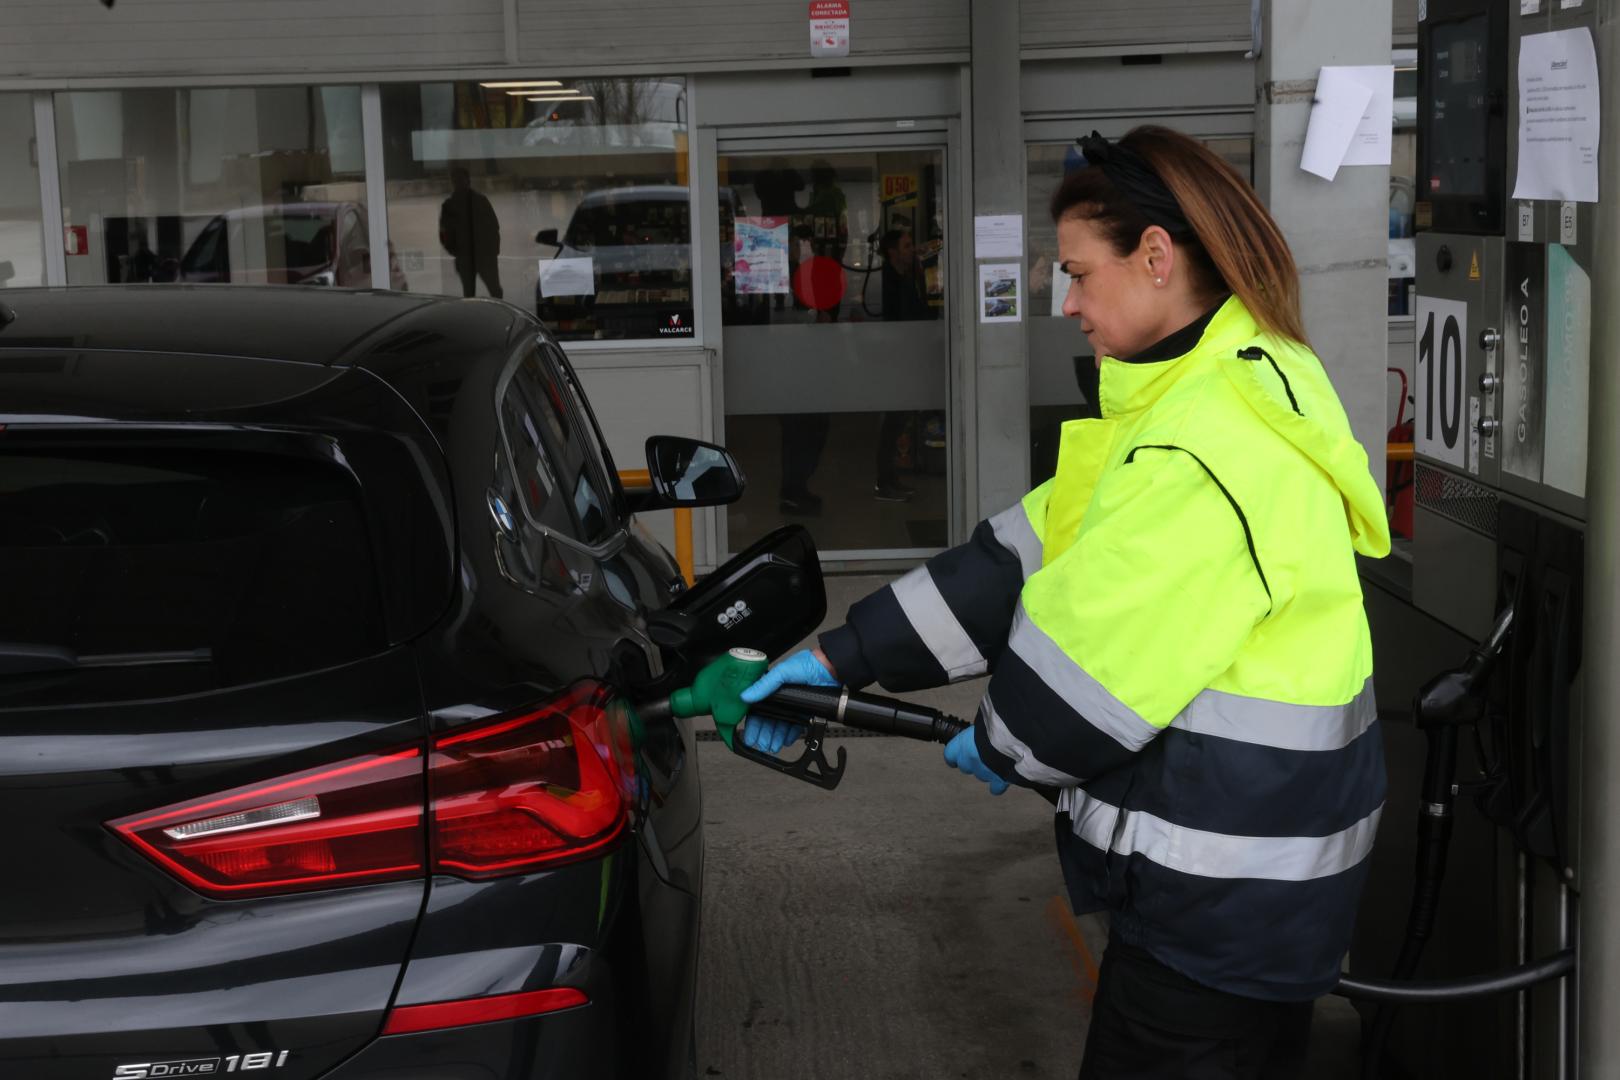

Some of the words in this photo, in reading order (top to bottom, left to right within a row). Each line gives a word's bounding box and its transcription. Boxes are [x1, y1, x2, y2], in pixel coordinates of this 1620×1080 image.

[1522, 214, 1529, 227] B7
[1520, 277, 1529, 298] A
[659, 326, 692, 334] VALCARCE
[1419, 311, 1462, 450] 10
[1517, 304, 1529, 443] GASOLEO
